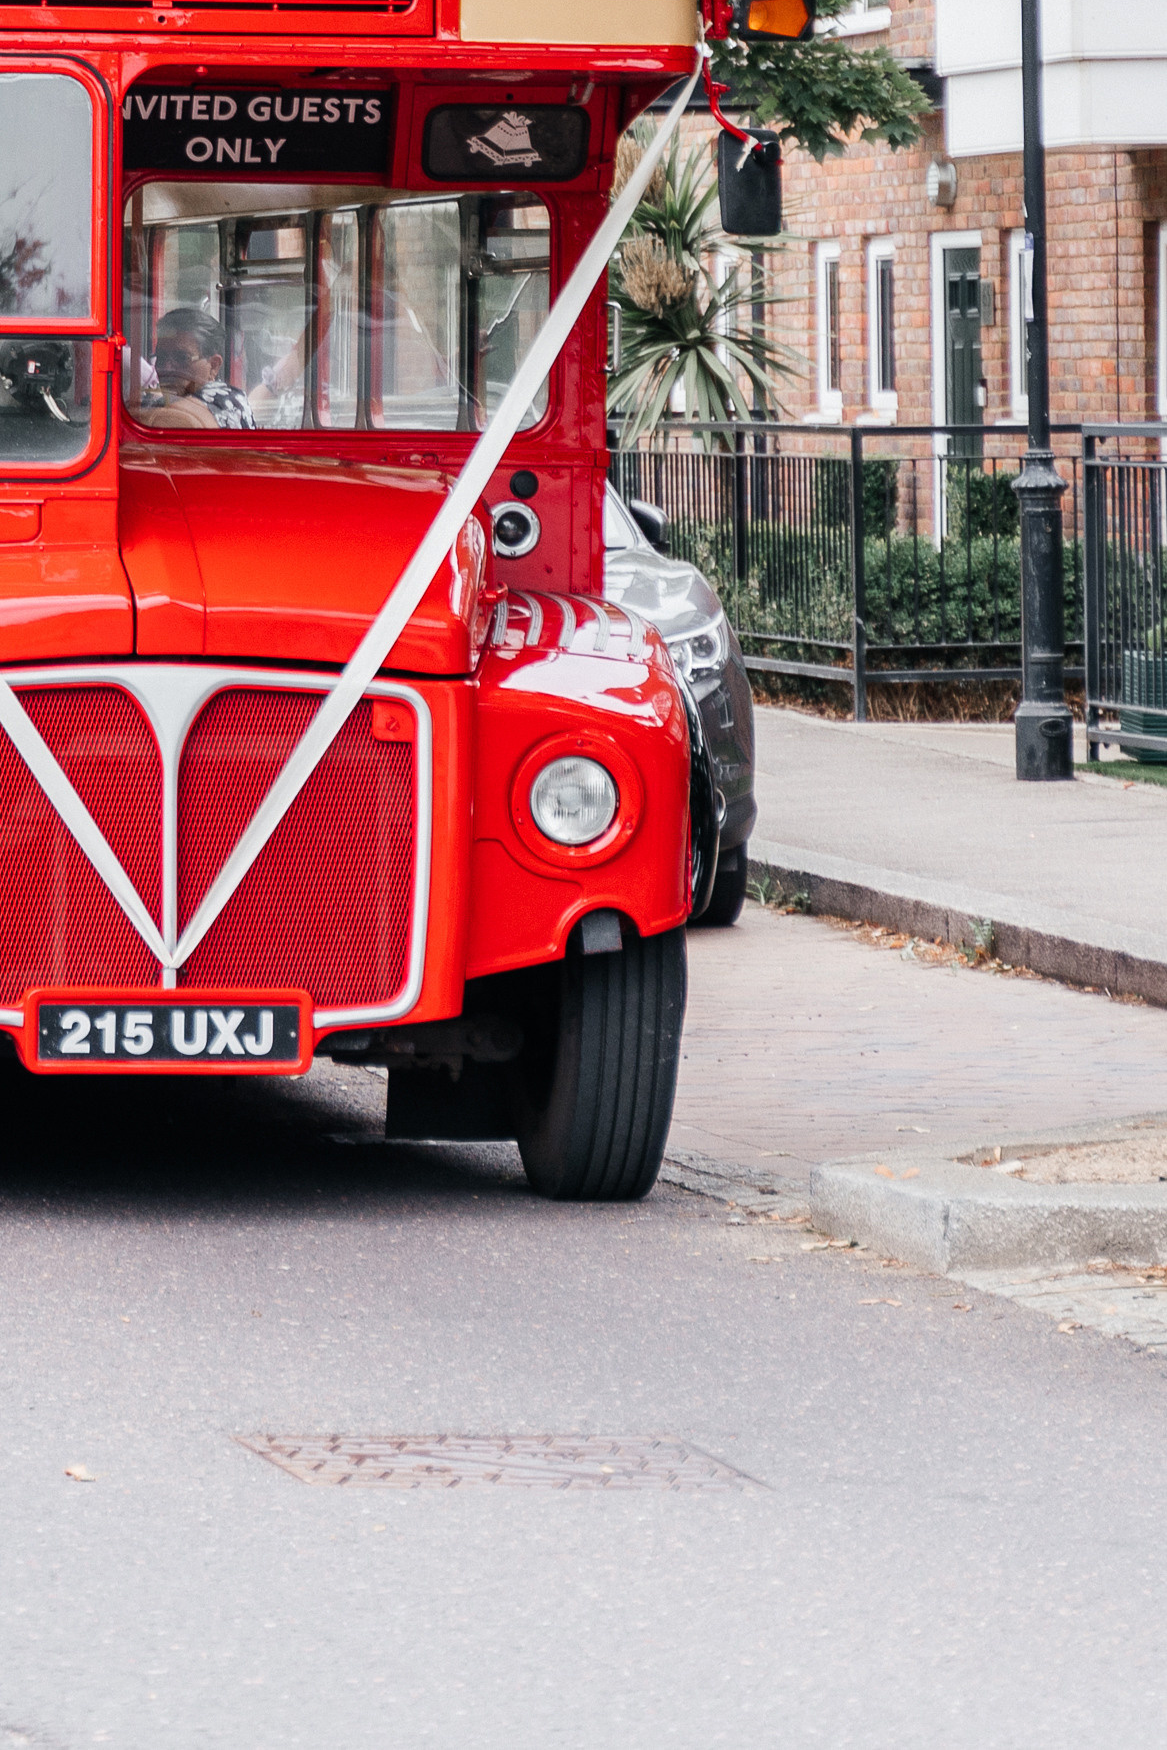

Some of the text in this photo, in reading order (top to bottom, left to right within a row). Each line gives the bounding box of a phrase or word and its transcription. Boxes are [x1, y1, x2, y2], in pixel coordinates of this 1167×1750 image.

[247, 96, 382, 125] GUESTS
[185, 136, 287, 164] ONLY
[60, 1009, 274, 1056] 215 UXJ
